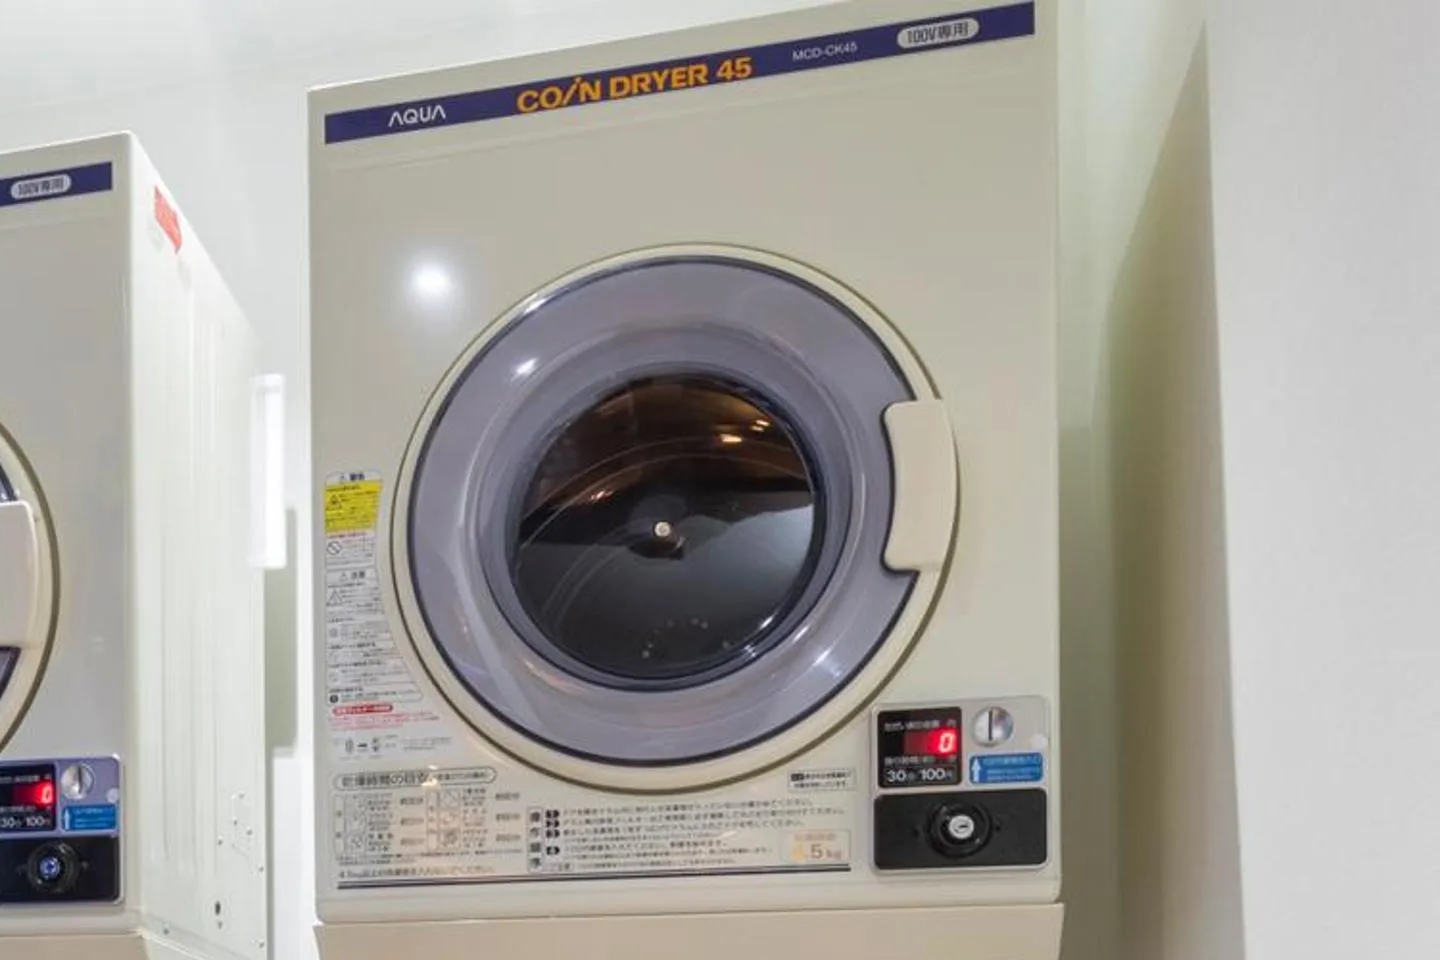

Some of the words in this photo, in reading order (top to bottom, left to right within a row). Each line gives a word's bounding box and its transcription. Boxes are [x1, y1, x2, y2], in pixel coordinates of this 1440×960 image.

[610, 64, 707, 98] DRYER
[717, 56, 752, 81] 45
[388, 105, 446, 127] AQUA
[939, 732, 956, 753] 0
[41, 782, 53, 804] 0
